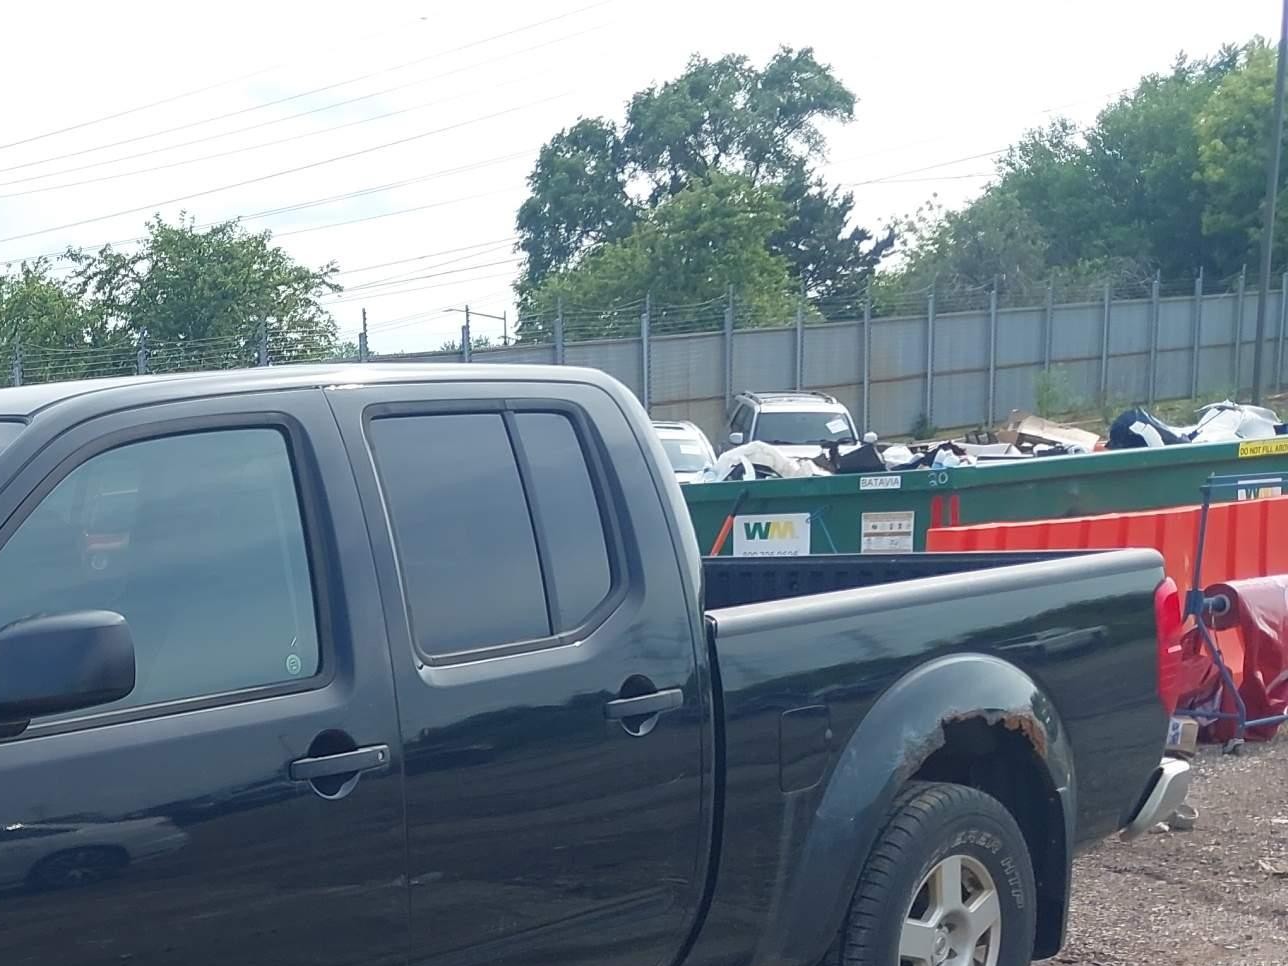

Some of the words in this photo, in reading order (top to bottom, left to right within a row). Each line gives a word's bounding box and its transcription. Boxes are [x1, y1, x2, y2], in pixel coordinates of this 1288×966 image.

[1240, 447, 1249, 455] DO
[1250, 446, 1261, 454] NOT
[861, 478, 900, 487] BATAVIA
[743, 521, 795, 541] WM
